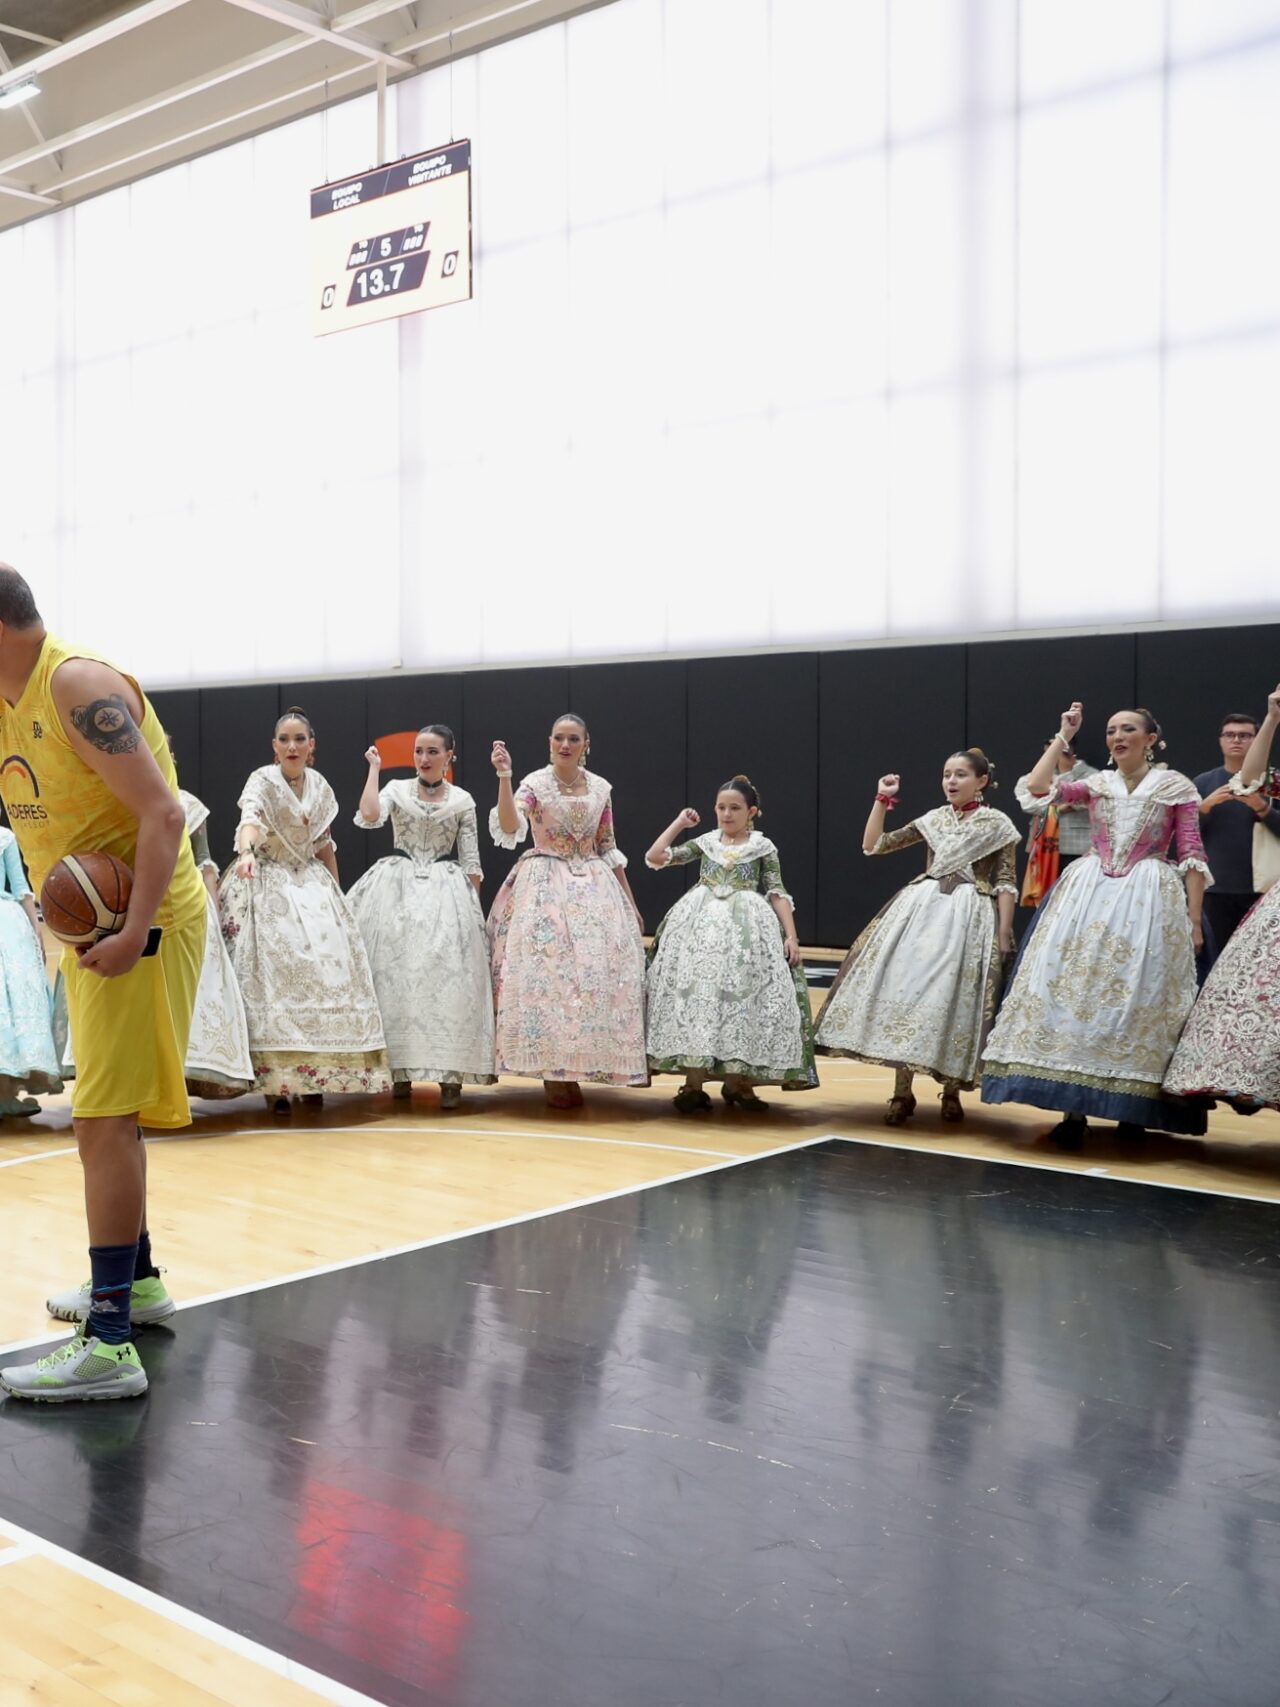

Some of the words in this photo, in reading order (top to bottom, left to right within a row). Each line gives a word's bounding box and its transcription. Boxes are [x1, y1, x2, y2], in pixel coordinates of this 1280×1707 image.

[413, 154, 446, 174] EQUIPO
[408, 163, 452, 186] VISITANTE
[332, 182, 362, 200] EQUIPO
[333, 193, 360, 210] LOCAL
[380, 237, 392, 257] 5
[443, 253, 457, 276] 0
[357, 262, 405, 298] 13.7
[323, 287, 334, 308] 0
